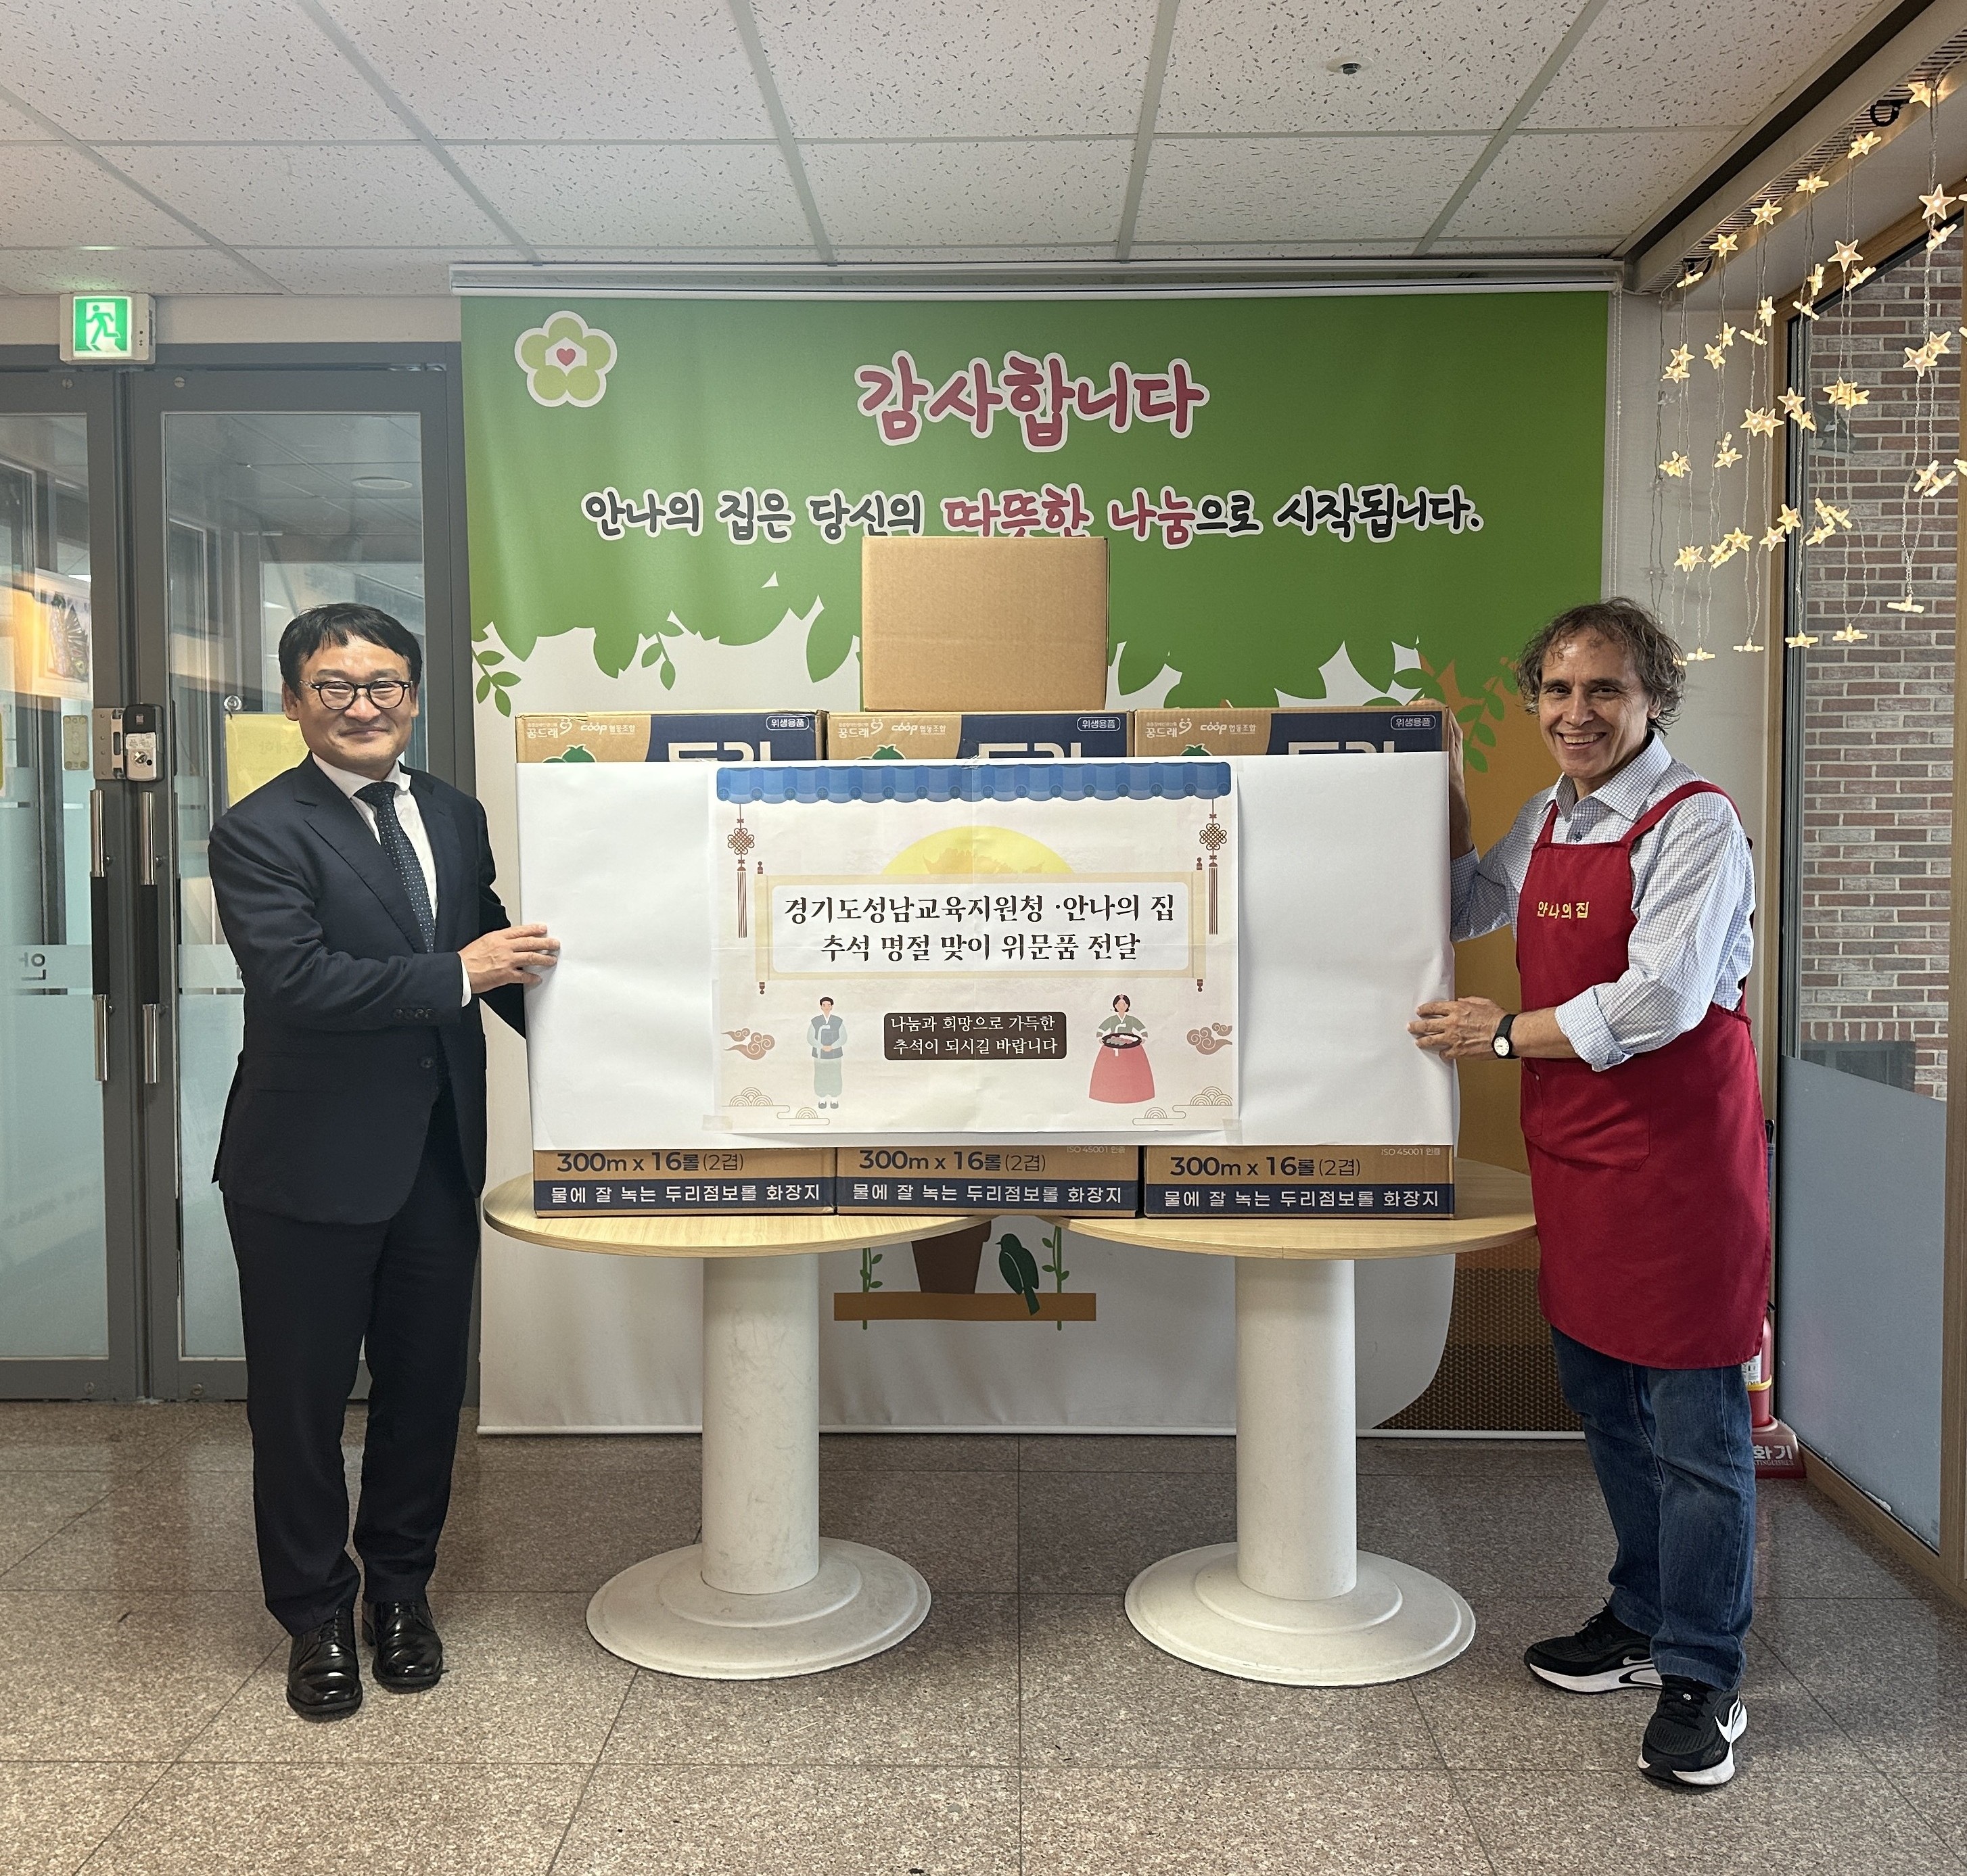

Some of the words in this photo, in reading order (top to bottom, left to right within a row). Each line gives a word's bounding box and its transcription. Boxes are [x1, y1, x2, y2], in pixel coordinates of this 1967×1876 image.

[857, 354, 1207, 449] 감사합니다
[584, 488, 701, 536] 안나의
[718, 489, 793, 542] 집은
[808, 490, 922, 539] 당신의
[943, 486, 1091, 536] 따뜻한
[1109, 488, 1261, 547] 나눔으로
[1275, 485, 1483, 540] 시작됩니다.
[1082, 719, 1116, 729] 위생용품
[1395, 717, 1431, 727] 위생용품
[527, 728, 559, 738] 꿈드래
[838, 728, 869, 738] 꿈드래
[1145, 727, 1178, 738] 꿈드래
[784, 895, 1044, 924] 경기도성남교육지원청
[1150, 893, 1175, 922] 집
[1537, 901, 1572, 919] 안나의
[1575, 901, 1590, 918] 집
[820, 934, 870, 962] 추석
[881, 933, 931, 962] 명절
[940, 933, 990, 962] 맞이
[1000, 933, 1080, 961] 위문품
[1088, 933, 1140, 960] 전달
[890, 1016, 938, 1033] 나눔과
[942, 1015, 1004, 1032] 희망으로
[1009, 1015, 1056, 1032] 가득한
[893, 1038, 939, 1055] 추석이
[945, 1038, 990, 1055] 되시길
[996, 1037, 1058, 1054] 바랍니다
[1066, 1146, 1081, 1154] ISO
[1082, 1146, 1109, 1154] 45001
[557, 1152, 627, 1173] 300m
[858, 1150, 929, 1170] 300m
[1170, 1156, 1241, 1177] 300m
[551, 1186, 586, 1204] 물에
[595, 1186, 612, 1203] 잘
[621, 1186, 656, 1203] 녹는
[665, 1185, 757, 1203] 두리점보롤
[766, 1183, 820, 1201] 화장지
[852, 1183, 887, 1201] 물에
[897, 1184, 913, 1201] 잘
[922, 1184, 958, 1202] 녹는
[967, 1186, 1059, 1203] 두리점보롤
[1067, 1186, 1121, 1204] 화장지
[1163, 1191, 1200, 1207] 물에
[1209, 1191, 1226, 1207] 잘
[1235, 1191, 1271, 1207] 녹는
[1280, 1190, 1374, 1207] 두리점보롤
[1383, 1190, 1439, 1207] 화장지
